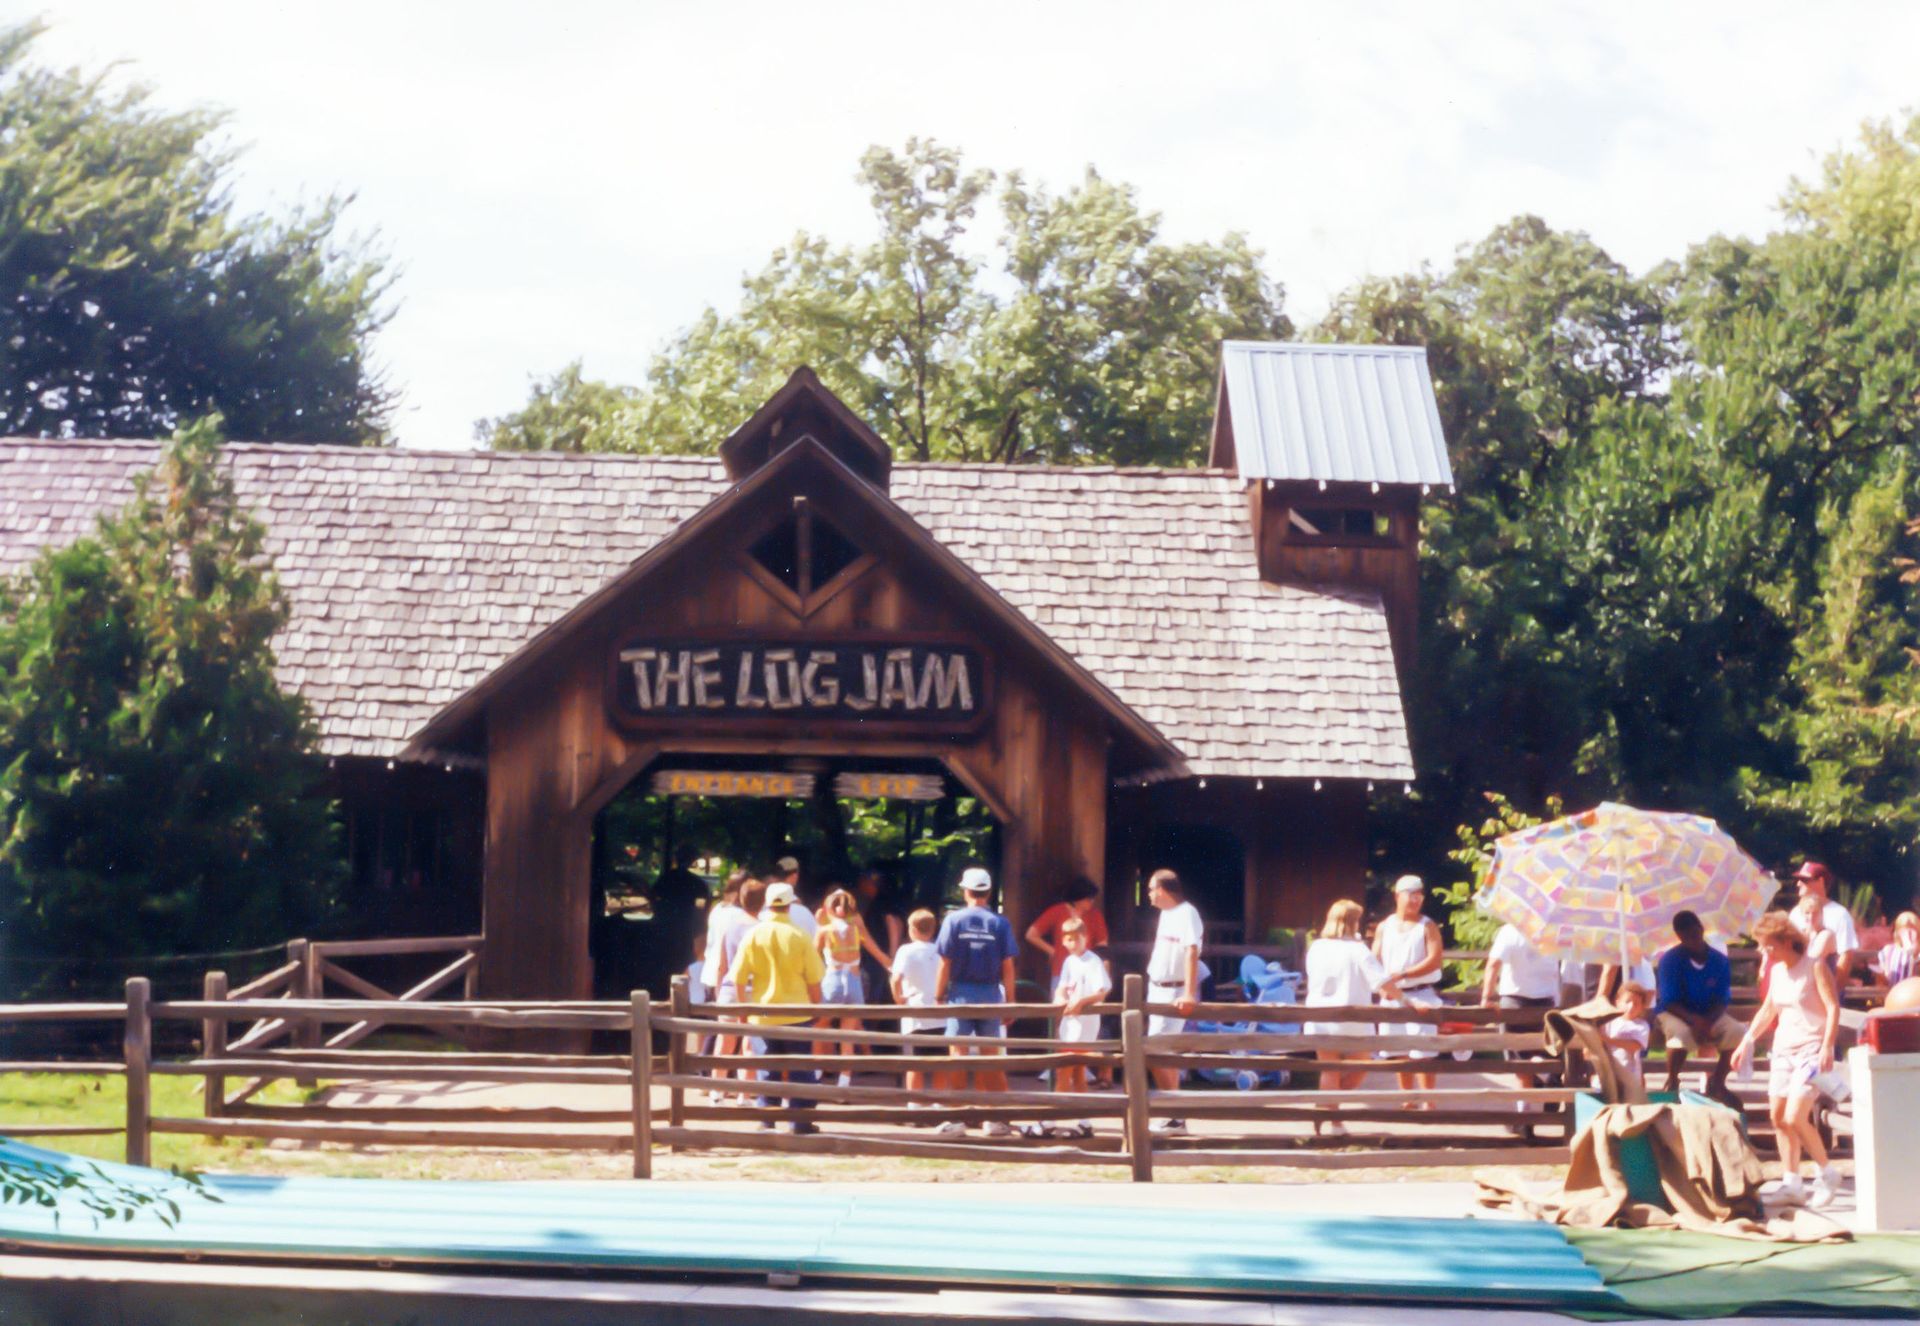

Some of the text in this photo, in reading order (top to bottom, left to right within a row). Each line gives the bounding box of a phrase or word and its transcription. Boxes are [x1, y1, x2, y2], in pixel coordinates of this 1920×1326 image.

[619, 647, 974, 711] THE LOG JAM
[670, 774, 795, 795] ENTRANCE
[859, 776, 920, 796] EXIT
